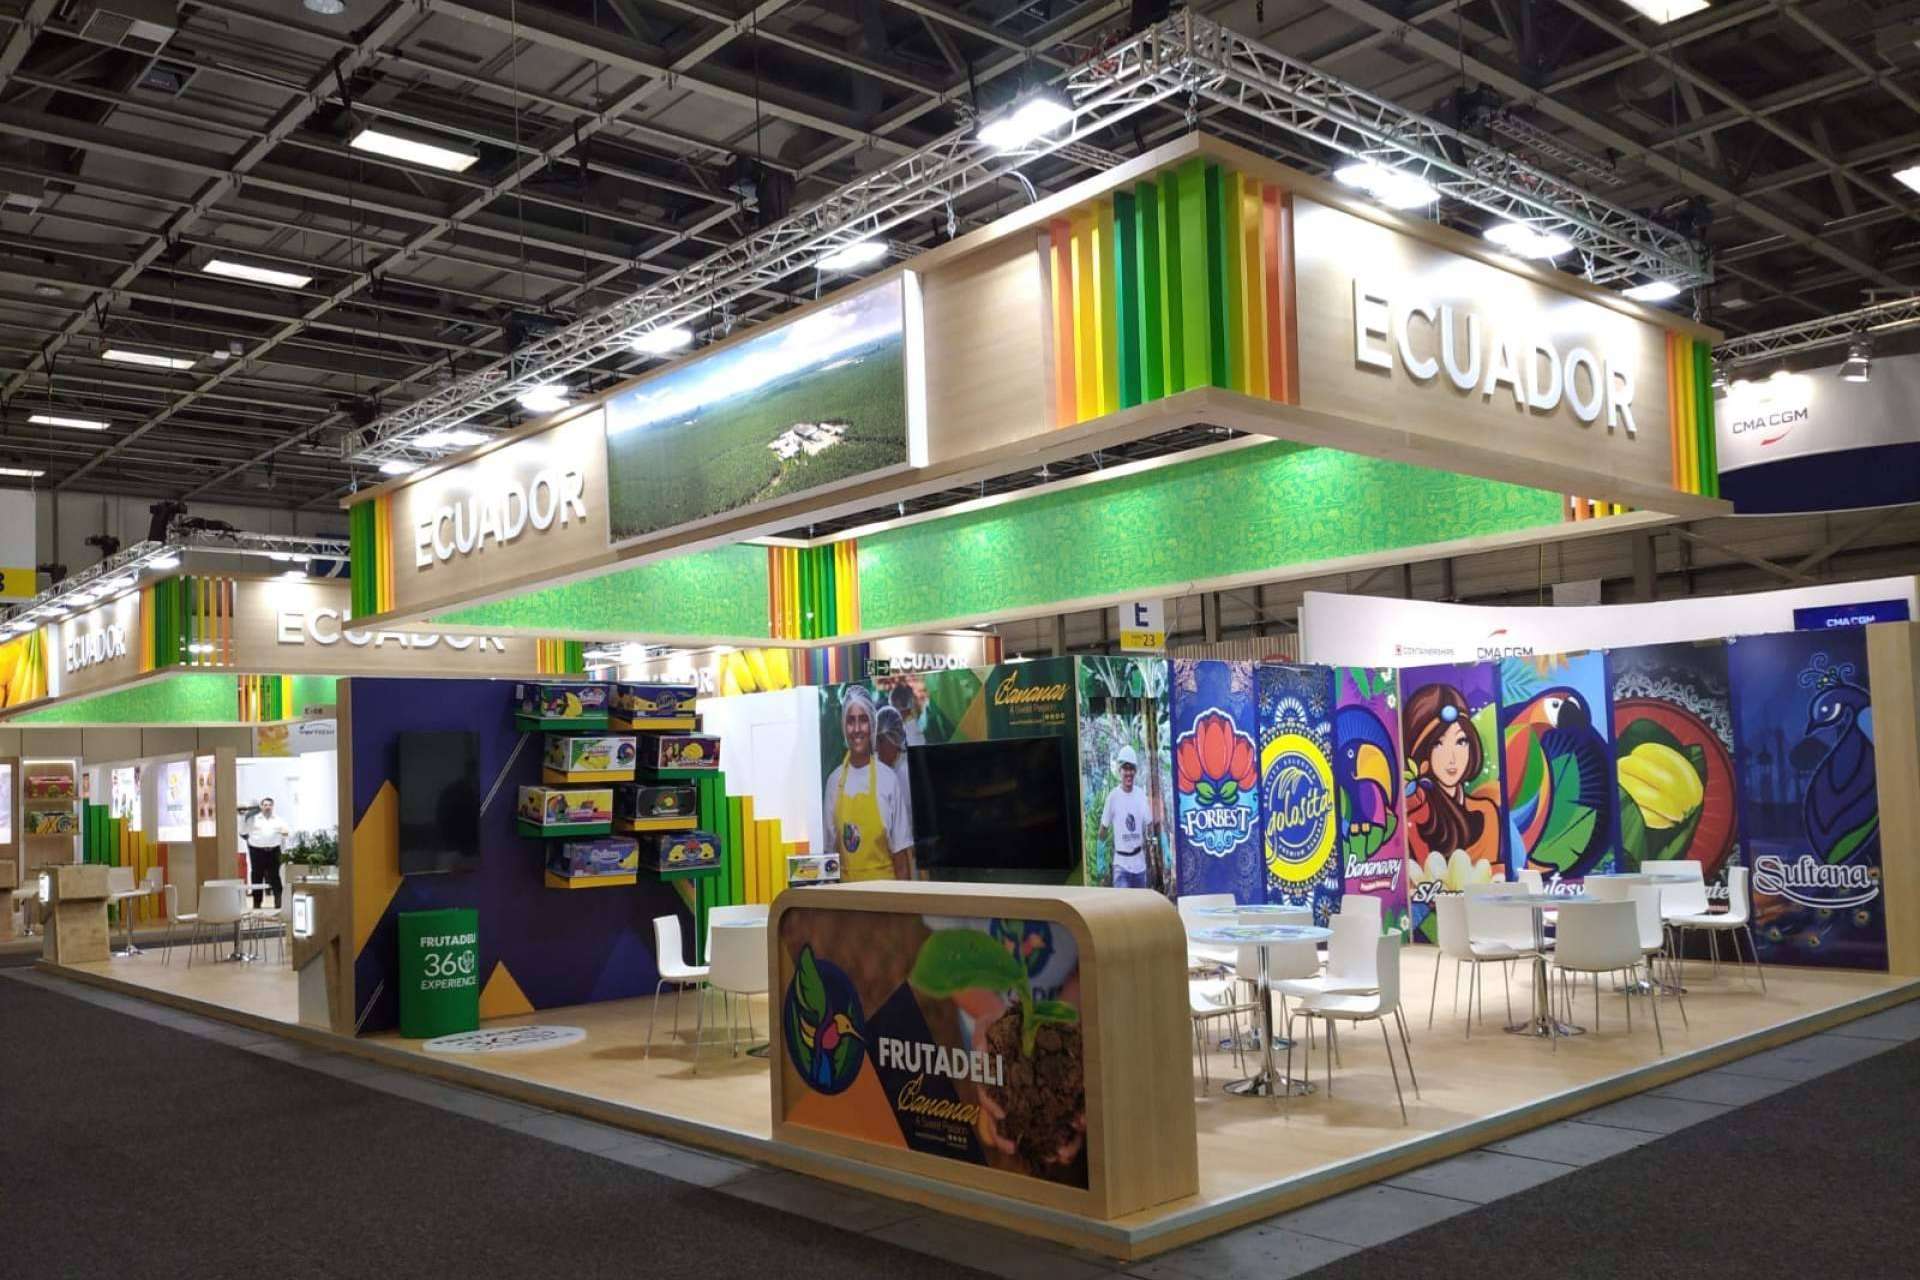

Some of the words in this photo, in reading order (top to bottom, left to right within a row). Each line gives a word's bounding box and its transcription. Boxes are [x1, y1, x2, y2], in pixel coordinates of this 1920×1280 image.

[1351, 278, 1638, 434] ECUADOR
[1732, 416, 1766, 434] CMA
[1768, 407, 1808, 426] CGM
[415, 468, 586, 571] ECUADOR
[1143, 633, 1156, 647] 23
[1826, 617, 1850, 628] CMA
[65, 623, 126, 674] ECUADOR
[1476, 647, 1501, 659] CMA
[1504, 647, 1534, 657] CGM
[994, 669, 1069, 706] Bananas
[1185, 806, 1251, 836] FORBEST
[1753, 856, 1872, 899] Sultana
[420, 975, 477, 990] EXPERIENCE
[878, 1036, 1004, 1087] FRUTADELI
[897, 1073, 980, 1125] Bananas
